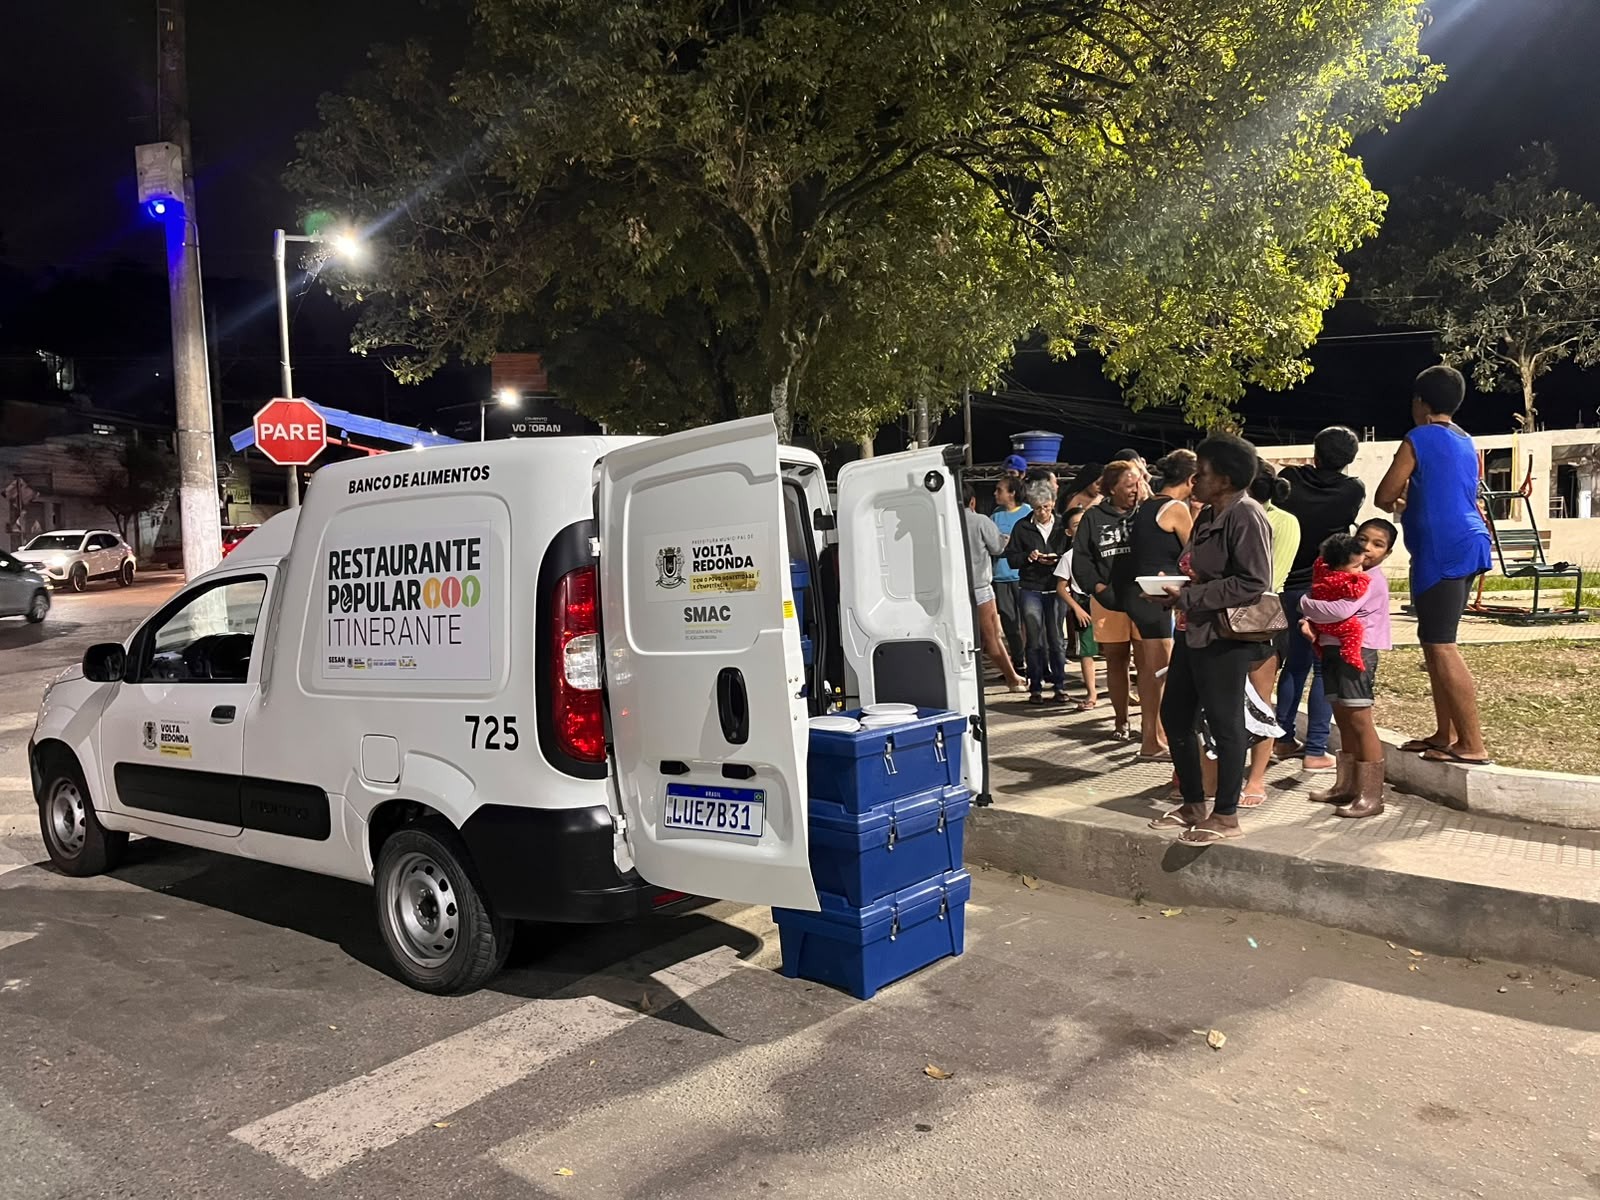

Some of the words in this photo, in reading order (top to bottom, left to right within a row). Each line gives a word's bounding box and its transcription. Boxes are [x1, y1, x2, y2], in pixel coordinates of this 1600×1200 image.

[260, 423, 321, 441] PARE
[348, 475, 391, 494] BANCO
[392, 473, 409, 489] DE
[410, 465, 490, 487] ALIMENTOS
[328, 537, 481, 580] RESTAURANTE
[692, 543, 733, 559] VOLTA
[692, 555, 754, 573] REDONDA
[328, 579, 421, 614] POPULAR
[683, 605, 731, 623] SMAC
[328, 614, 462, 647] ITINERANTE
[328, 656, 346, 664] SESAN
[160, 724, 180, 733] VOLTA
[465, 715, 519, 751] 725
[160, 733, 189, 744] REDONDA
[705, 790, 721, 798] BRASIL
[672, 798, 751, 831] LUE7B31
